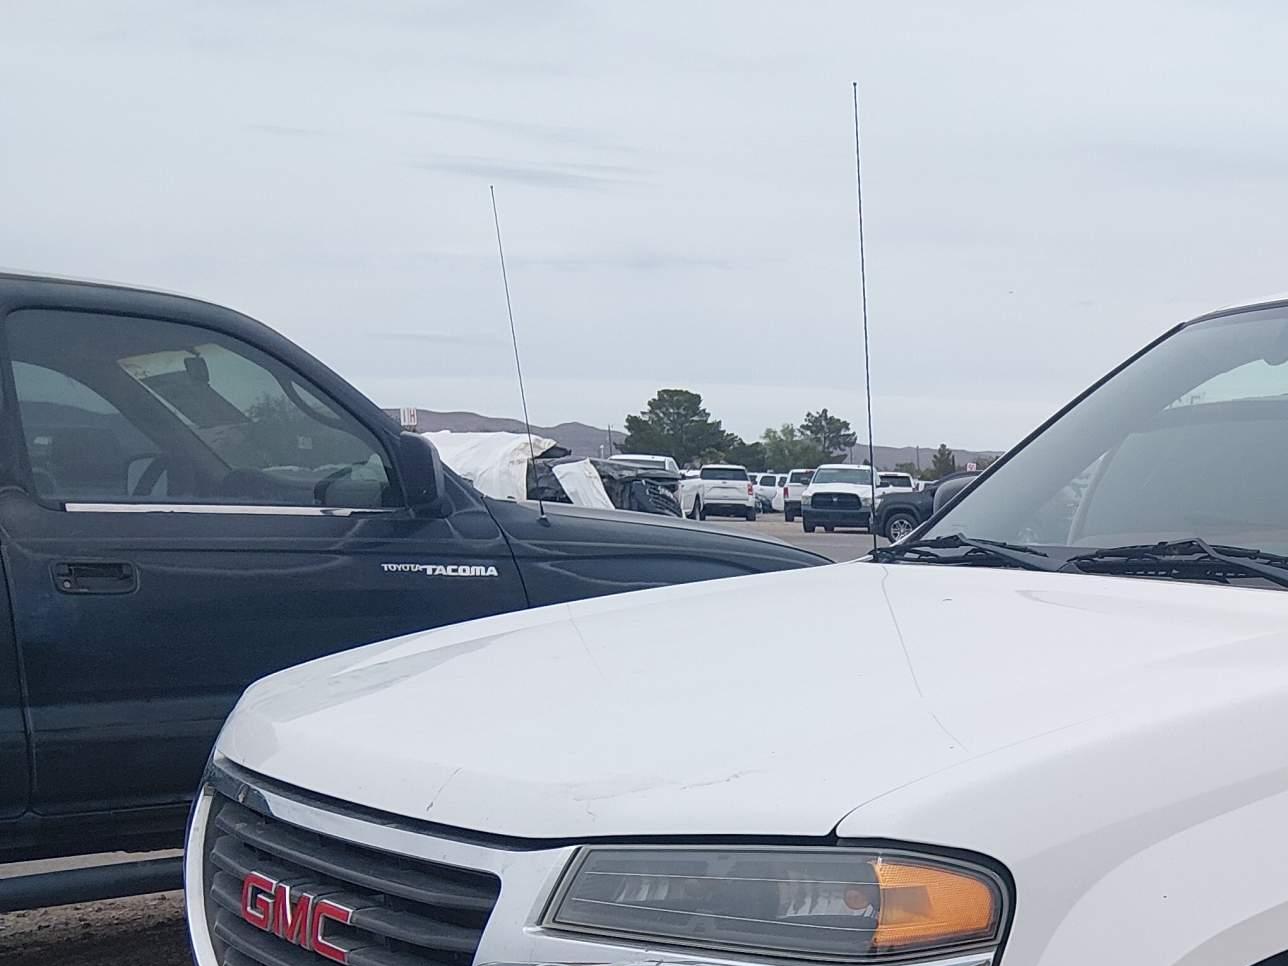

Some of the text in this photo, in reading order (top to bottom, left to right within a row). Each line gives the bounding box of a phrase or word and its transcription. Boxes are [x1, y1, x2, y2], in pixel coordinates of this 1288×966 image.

[381, 563, 498, 576] TOYOTA TACOMA
[240, 871, 354, 966] GMC
